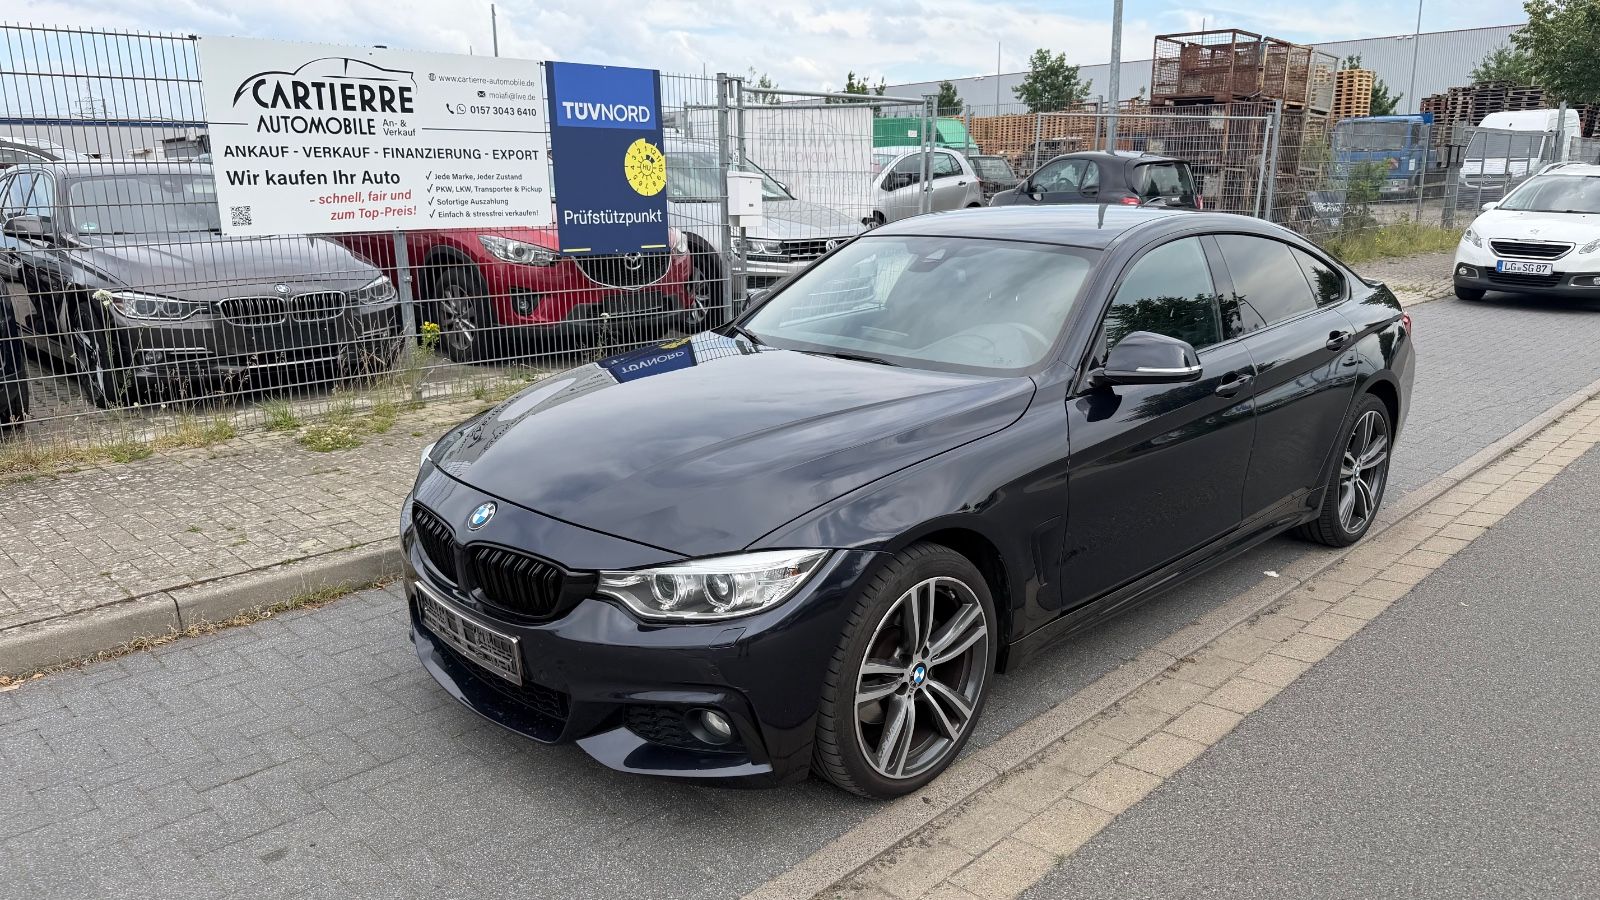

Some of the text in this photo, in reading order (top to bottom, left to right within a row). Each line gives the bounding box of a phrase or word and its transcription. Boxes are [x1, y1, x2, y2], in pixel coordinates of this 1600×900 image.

[252, 79, 414, 113] CARTIERRE
[470, 105, 537, 117] 0157 3043 6410
[256, 115, 376, 135] AUTOMOBILE
[382, 118, 407, 127] An- &
[382, 127, 416, 137] Verkauf
[223, 145, 289, 158] ANKAUF
[302, 146, 371, 159] VERKAUF
[382, 147, 482, 160] FINANZIERUNG
[492, 149, 539, 161] EXPORT
[226, 169, 401, 186] Wir kaufen Ihr Auto
[452, 173, 476, 181] Marke,
[496, 173, 523, 181] Zustand
[435, 185, 454, 193] PKW,
[474, 185, 513, 195] Transporter
[521, 186, 543, 195] Pickup
[318, 191, 365, 205] schnell,
[368, 190, 388, 202] fair
[390, 189, 412, 201] und
[436, 198, 509, 207] Sofortige Auszahlung
[330, 205, 417, 221] zum Top-Preis!
[472, 209, 504, 217] stressfrei
[504, 209, 539, 217] verkaufen!
[564, 208, 662, 227] Prüfstützpunkt
[1504, 262, 1548, 273] LG SG 87
